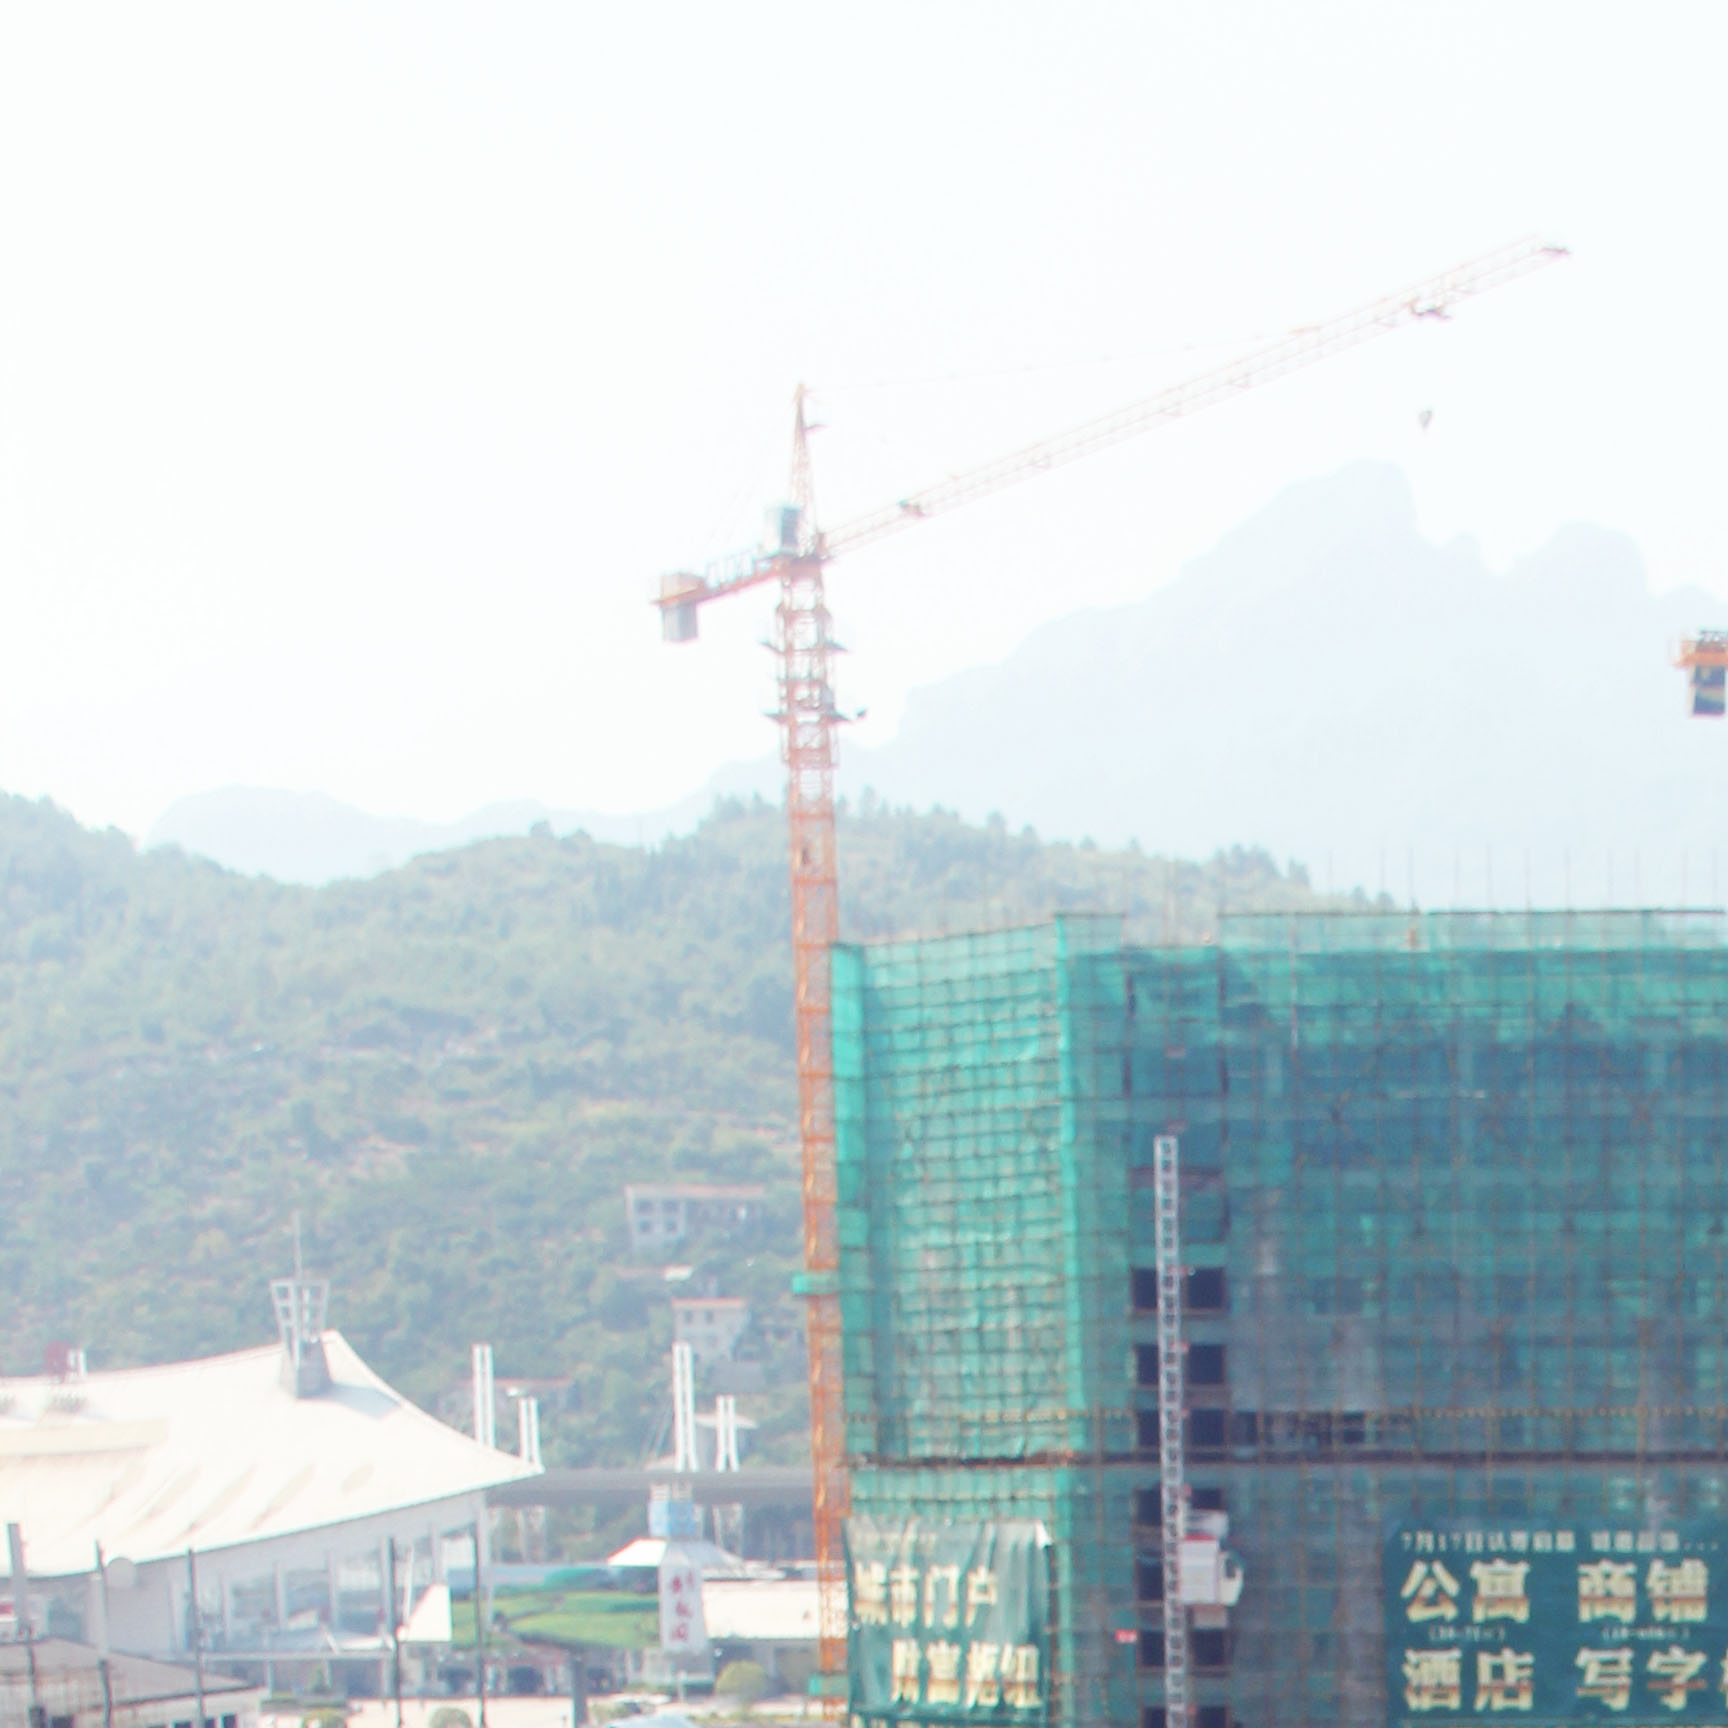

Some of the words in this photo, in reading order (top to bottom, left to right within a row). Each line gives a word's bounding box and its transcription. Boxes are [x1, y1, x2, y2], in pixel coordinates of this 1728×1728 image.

[1400, 1557, 1532, 1624] 公寓
[1577, 1557, 1709, 1624] 商铺
[1402, 1646, 1535, 1712] 酒店
